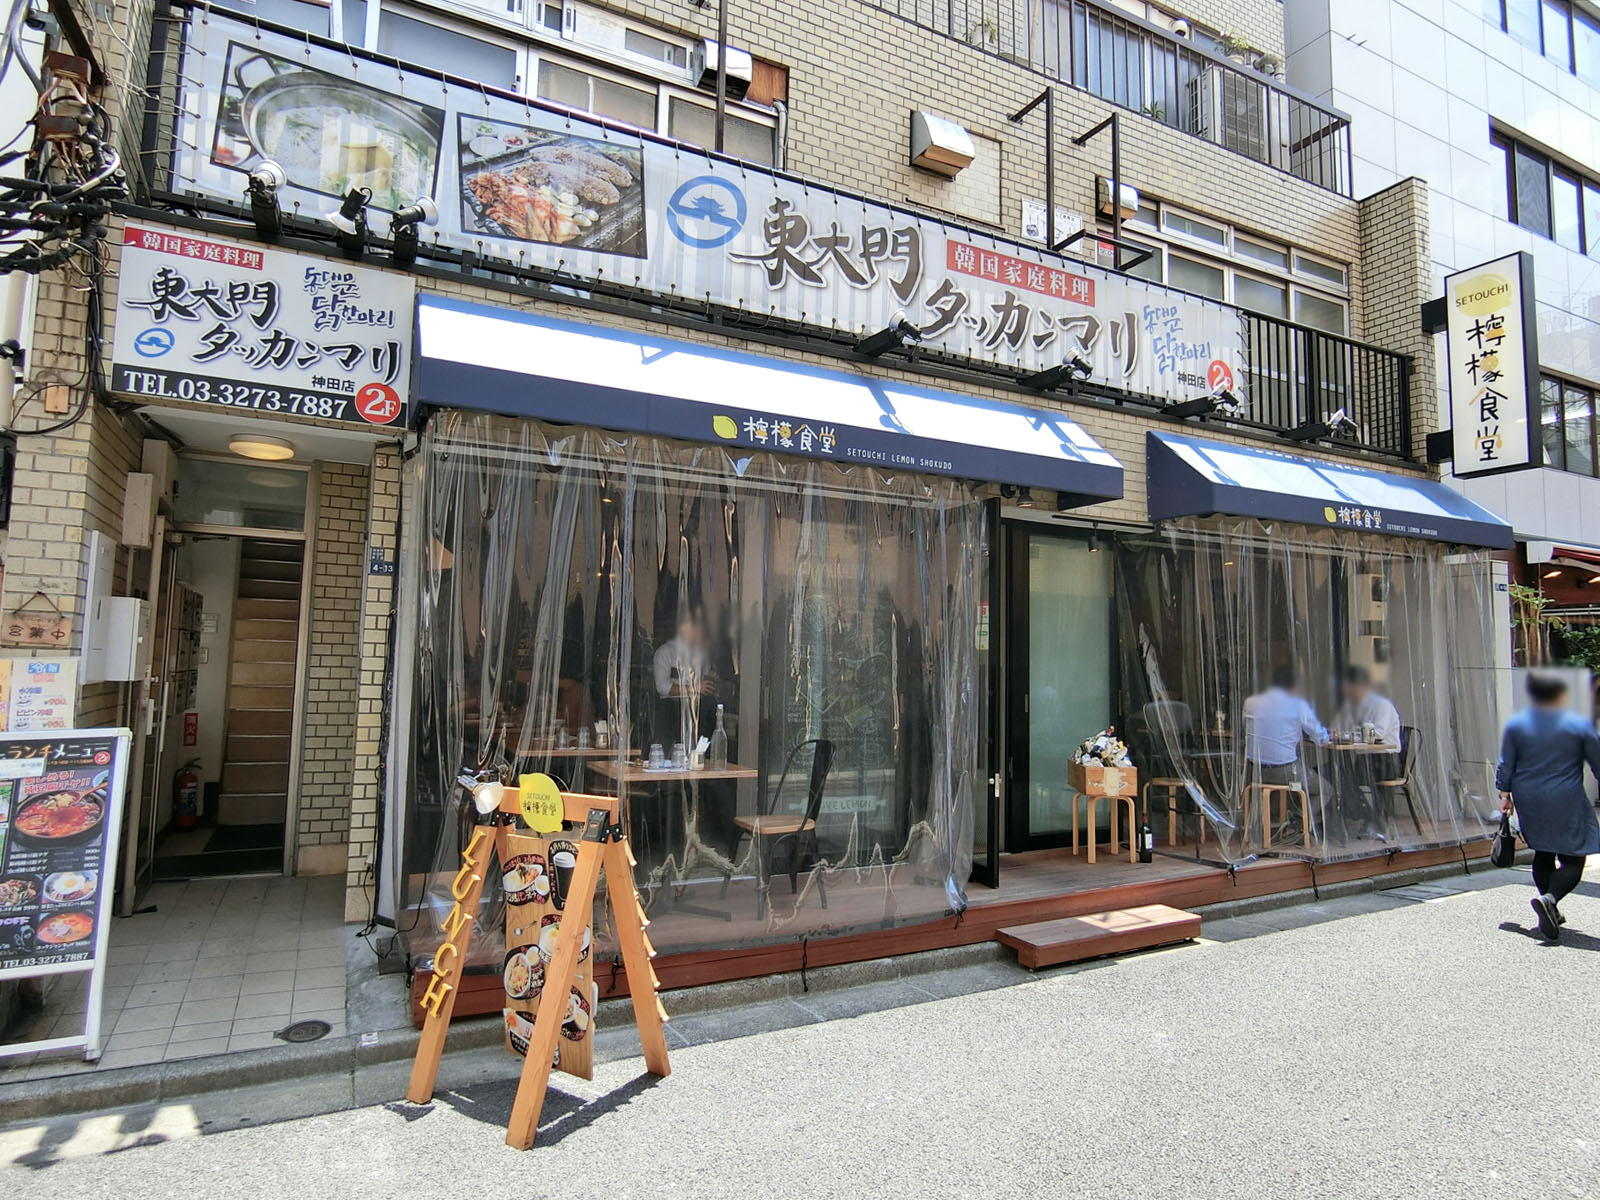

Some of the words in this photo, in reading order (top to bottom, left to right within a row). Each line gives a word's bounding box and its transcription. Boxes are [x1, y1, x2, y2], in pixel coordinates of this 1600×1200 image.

[142, 231, 261, 269] 韓国家庭料理
[728, 197, 920, 303] 東大門
[1099, 248, 1115, 257] SECO
[304, 267, 359, 297] 동대문
[955, 246, 1090, 303] 韓国家庭料理
[124, 266, 279, 329] 東大門
[1455, 283, 1509, 308] SETOUCHI
[920, 279, 1137, 375] タッカンマリ
[191, 323, 401, 384] タッカンマリ
[124, 370, 348, 419] TEL.03-3273-7887
[311, 375, 356, 393] 神田店
[1177, 370, 1206, 390] 神田店
[1464, 314, 1508, 462] 檸檬食堂
[364, 388, 397, 416] 2F
[742, 416, 837, 454] 檸檬食堂
[847, 447, 886, 461] SETOUCHI
[891, 454, 916, 465] LEMON
[919, 458, 953, 471] SHOKUDO
[419, 829, 488, 1019] LUNCH
